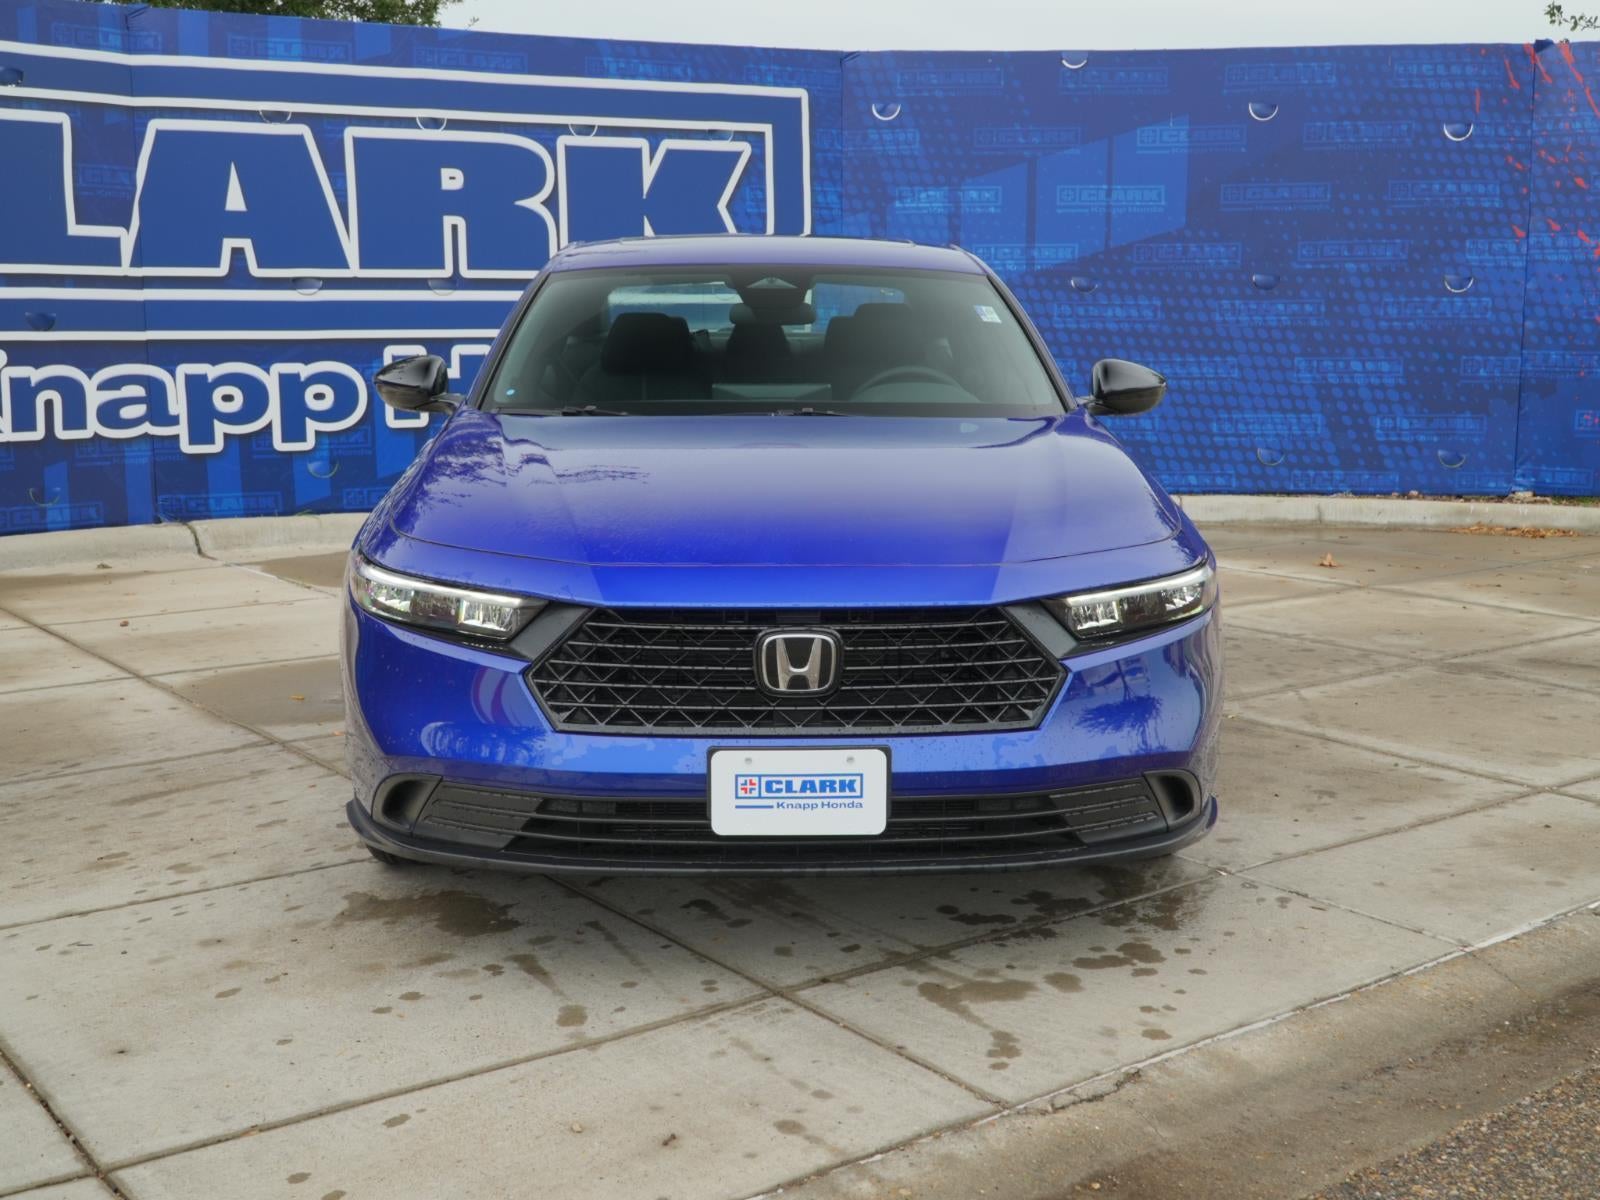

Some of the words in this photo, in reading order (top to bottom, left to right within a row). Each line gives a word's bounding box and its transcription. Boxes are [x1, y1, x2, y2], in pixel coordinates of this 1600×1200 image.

[0, 349, 367, 454] napp
[765, 778, 857, 794] CLARK
[776, 801, 819, 811] Knapp
[821, 800, 863, 809] Honda
